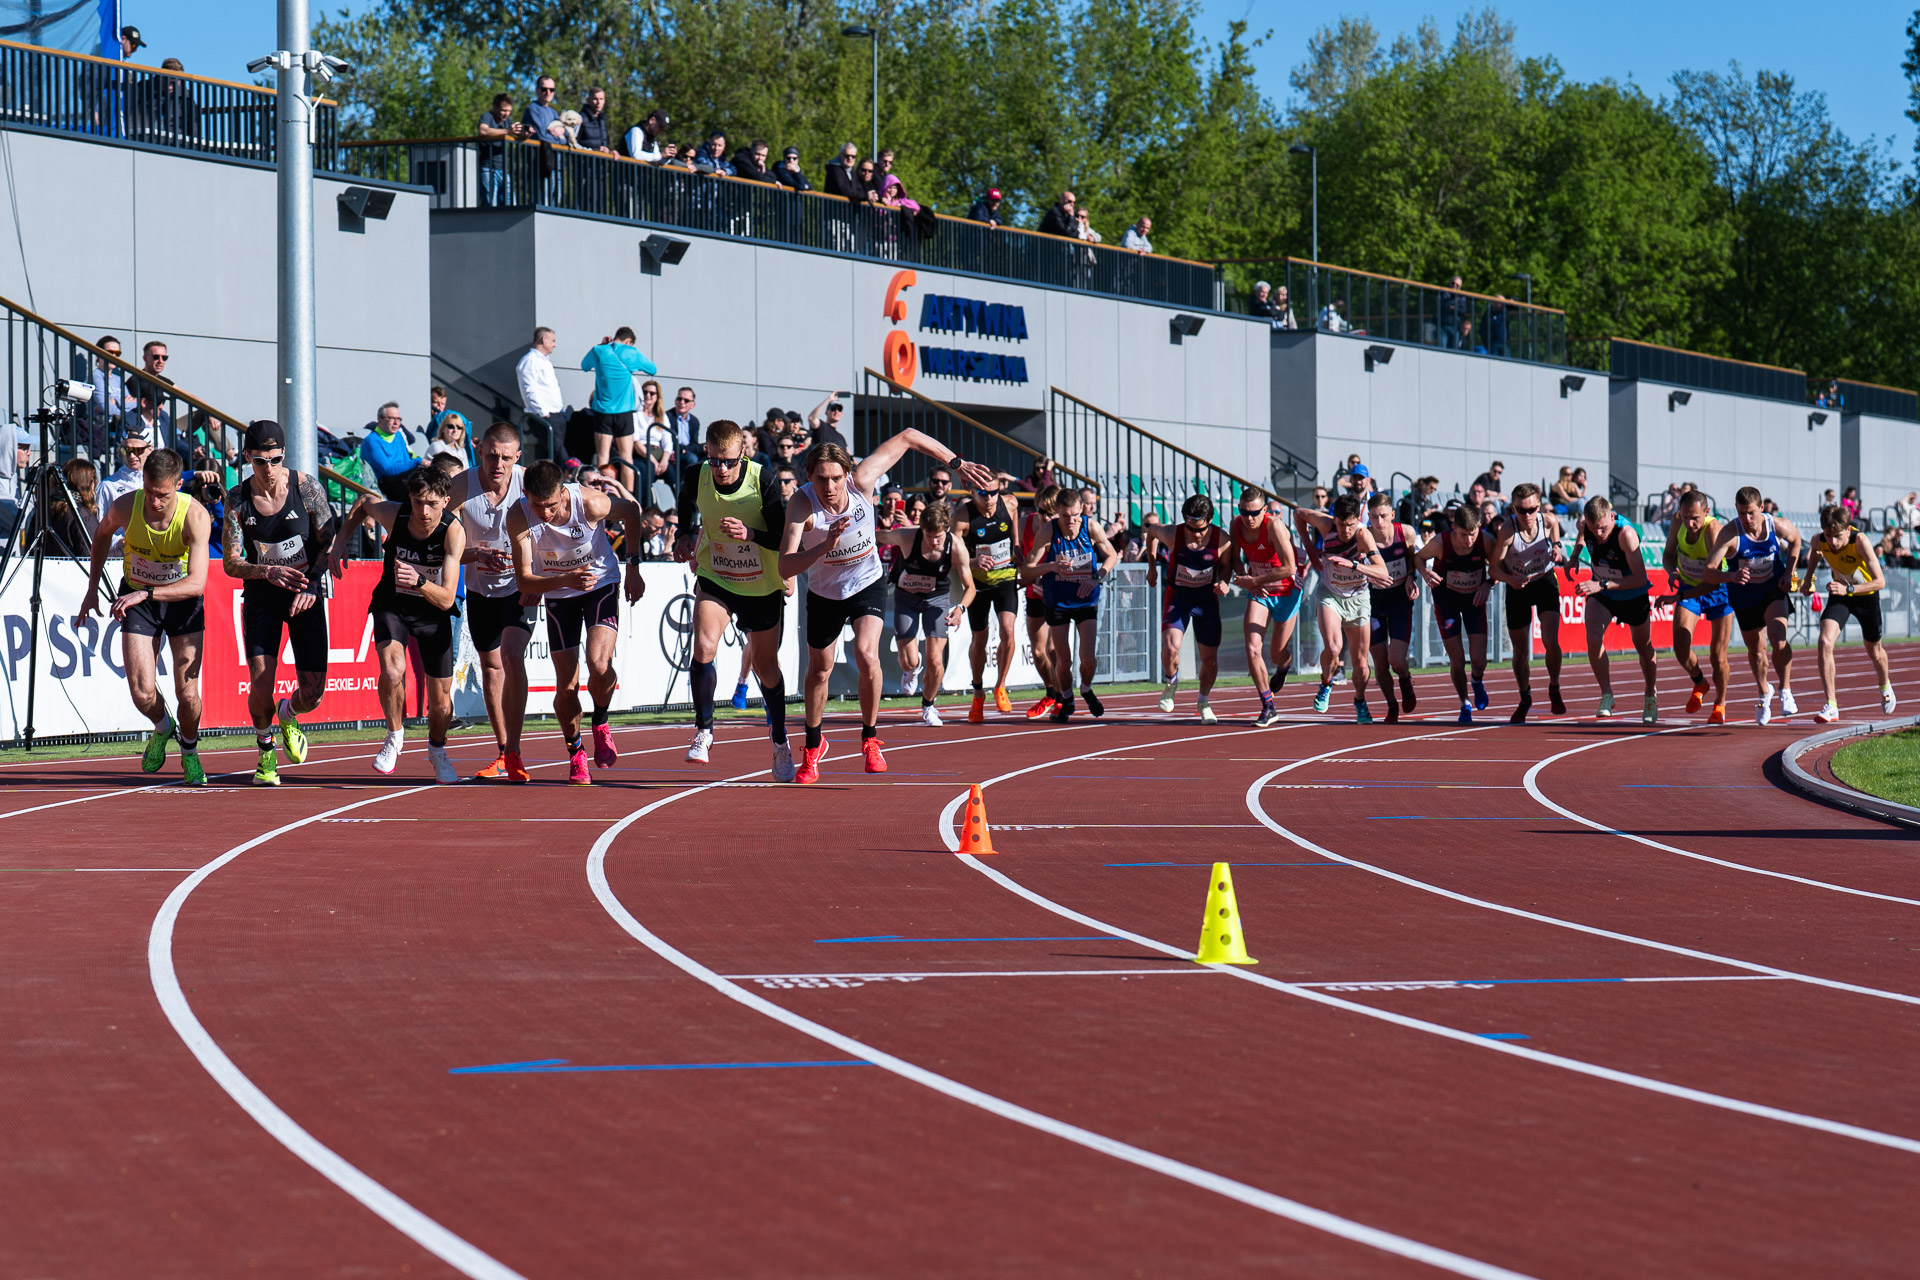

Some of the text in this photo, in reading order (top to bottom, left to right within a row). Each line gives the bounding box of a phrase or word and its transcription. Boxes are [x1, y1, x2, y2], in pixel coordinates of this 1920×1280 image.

[920, 294, 1028, 340] AKTYWNA
[920, 346, 1028, 383] WARSZAWA
[283, 541, 296, 551] 28
[738, 545, 751, 553] 24
[825, 537, 872, 558] ADAMCZAK
[260, 552, 305, 566] MACHOWSKI
[544, 554, 593, 567] WIECZOREK
[713, 556, 760, 568] KROCHMAL
[132, 567, 181, 581] LEOŃCZUK
